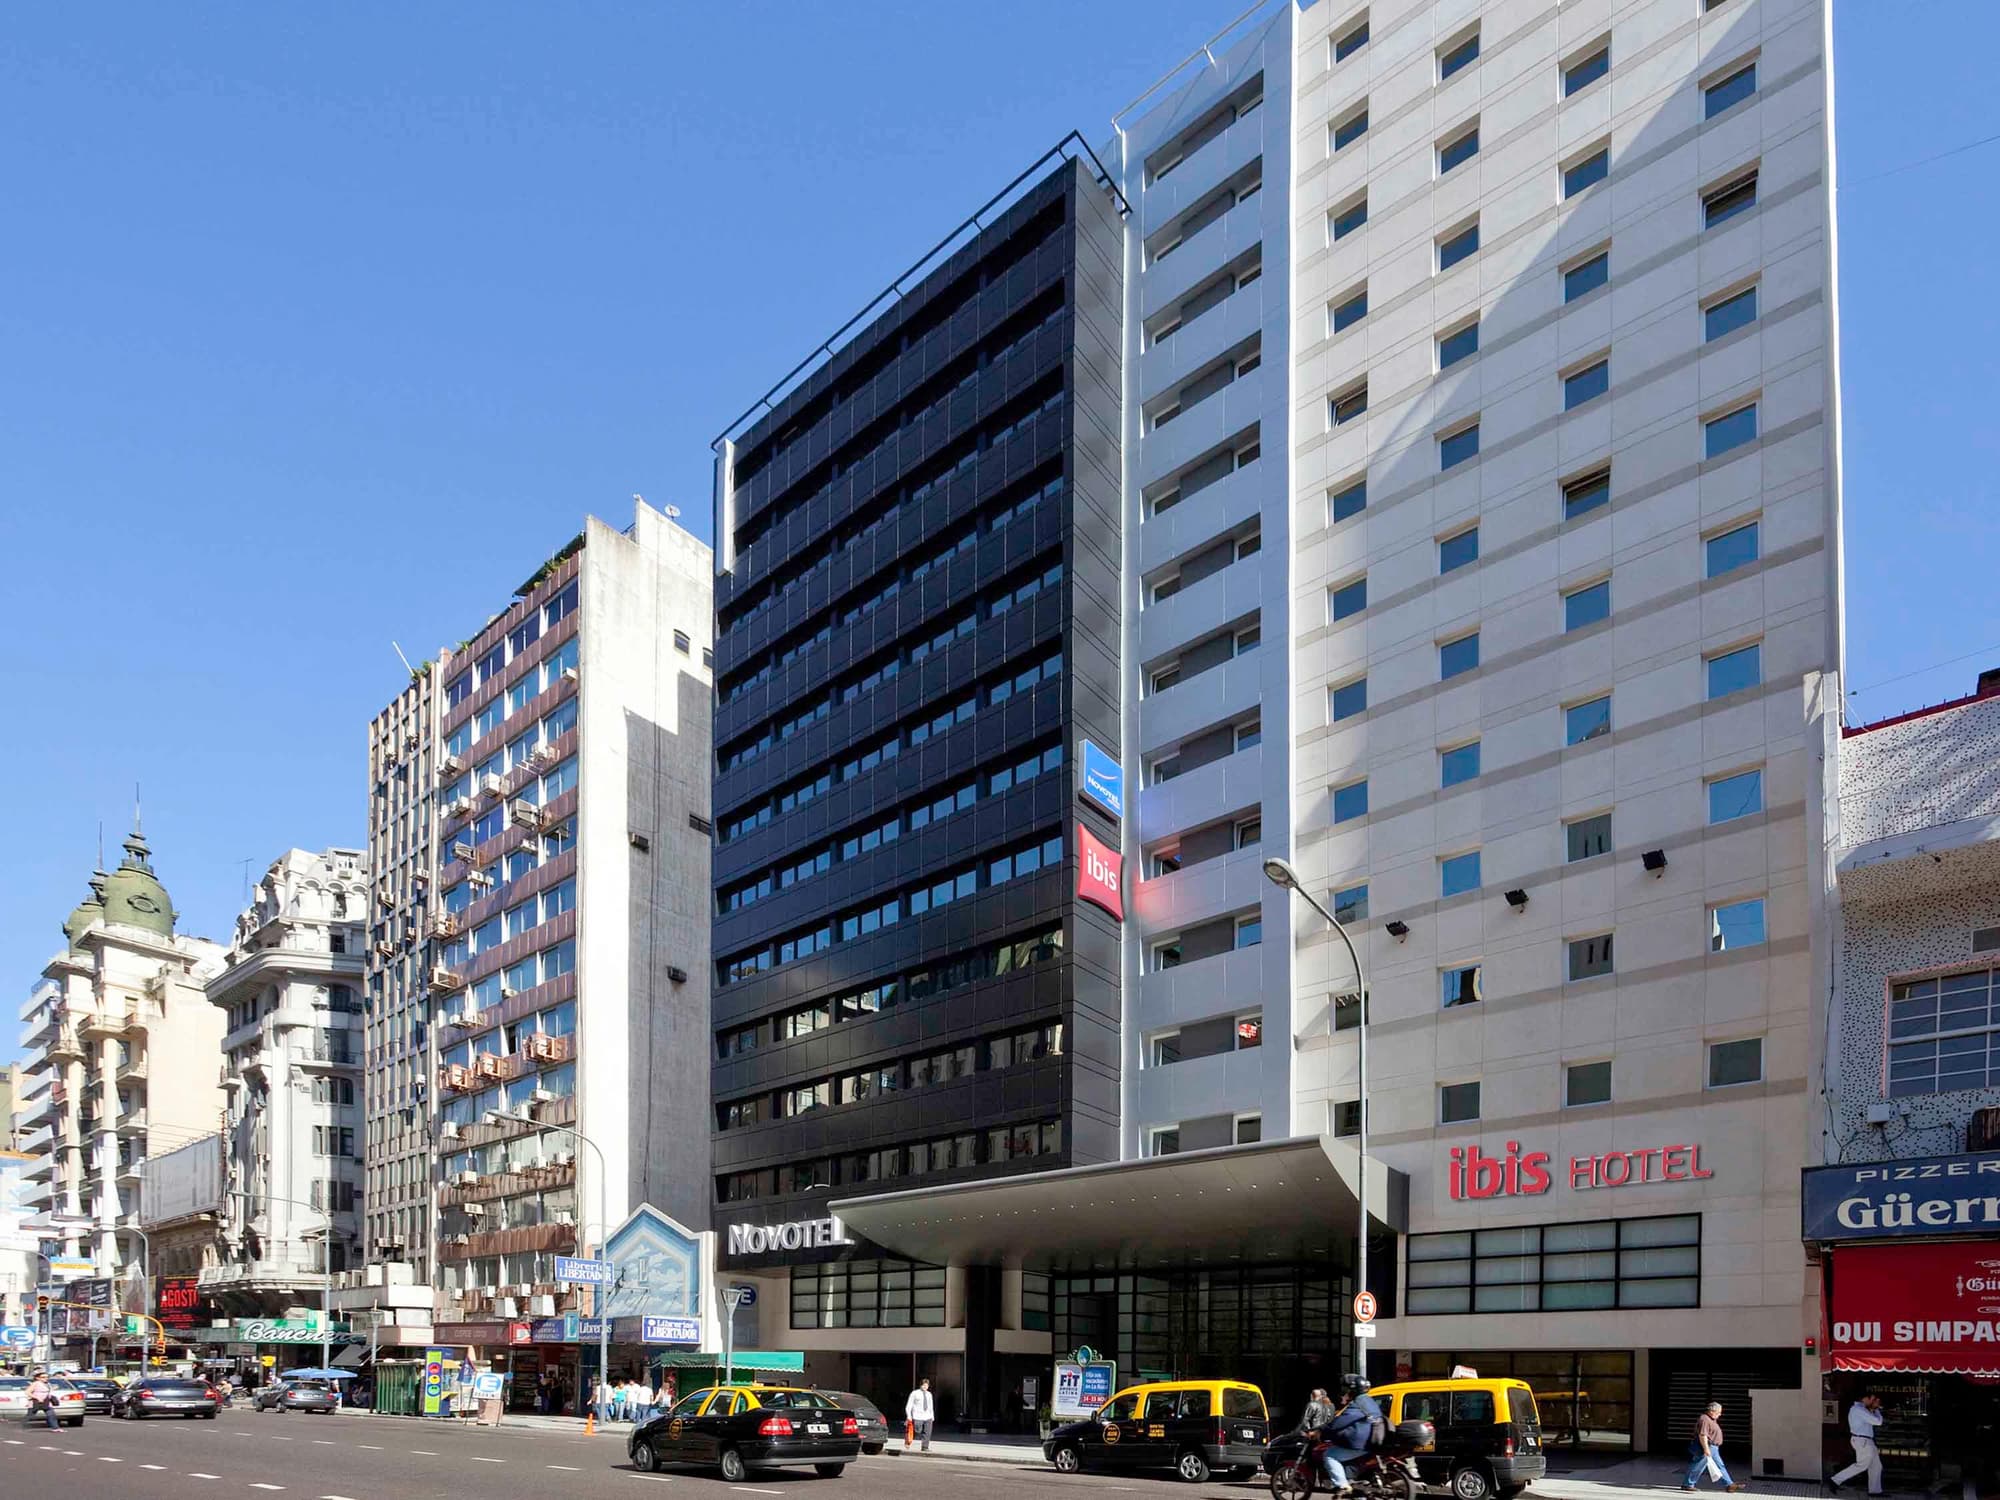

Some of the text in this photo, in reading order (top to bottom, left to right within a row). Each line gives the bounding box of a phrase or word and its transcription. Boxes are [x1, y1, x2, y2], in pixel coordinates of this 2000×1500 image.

[1088, 775, 1119, 803] NOVOTEL
[1087, 848, 1117, 891] ibis
[1449, 1140, 1713, 1201] ibis HOTEL
[728, 1213, 855, 1256] NOVOTEL
[1833, 1321, 2000, 1343] QUI SIMPA
